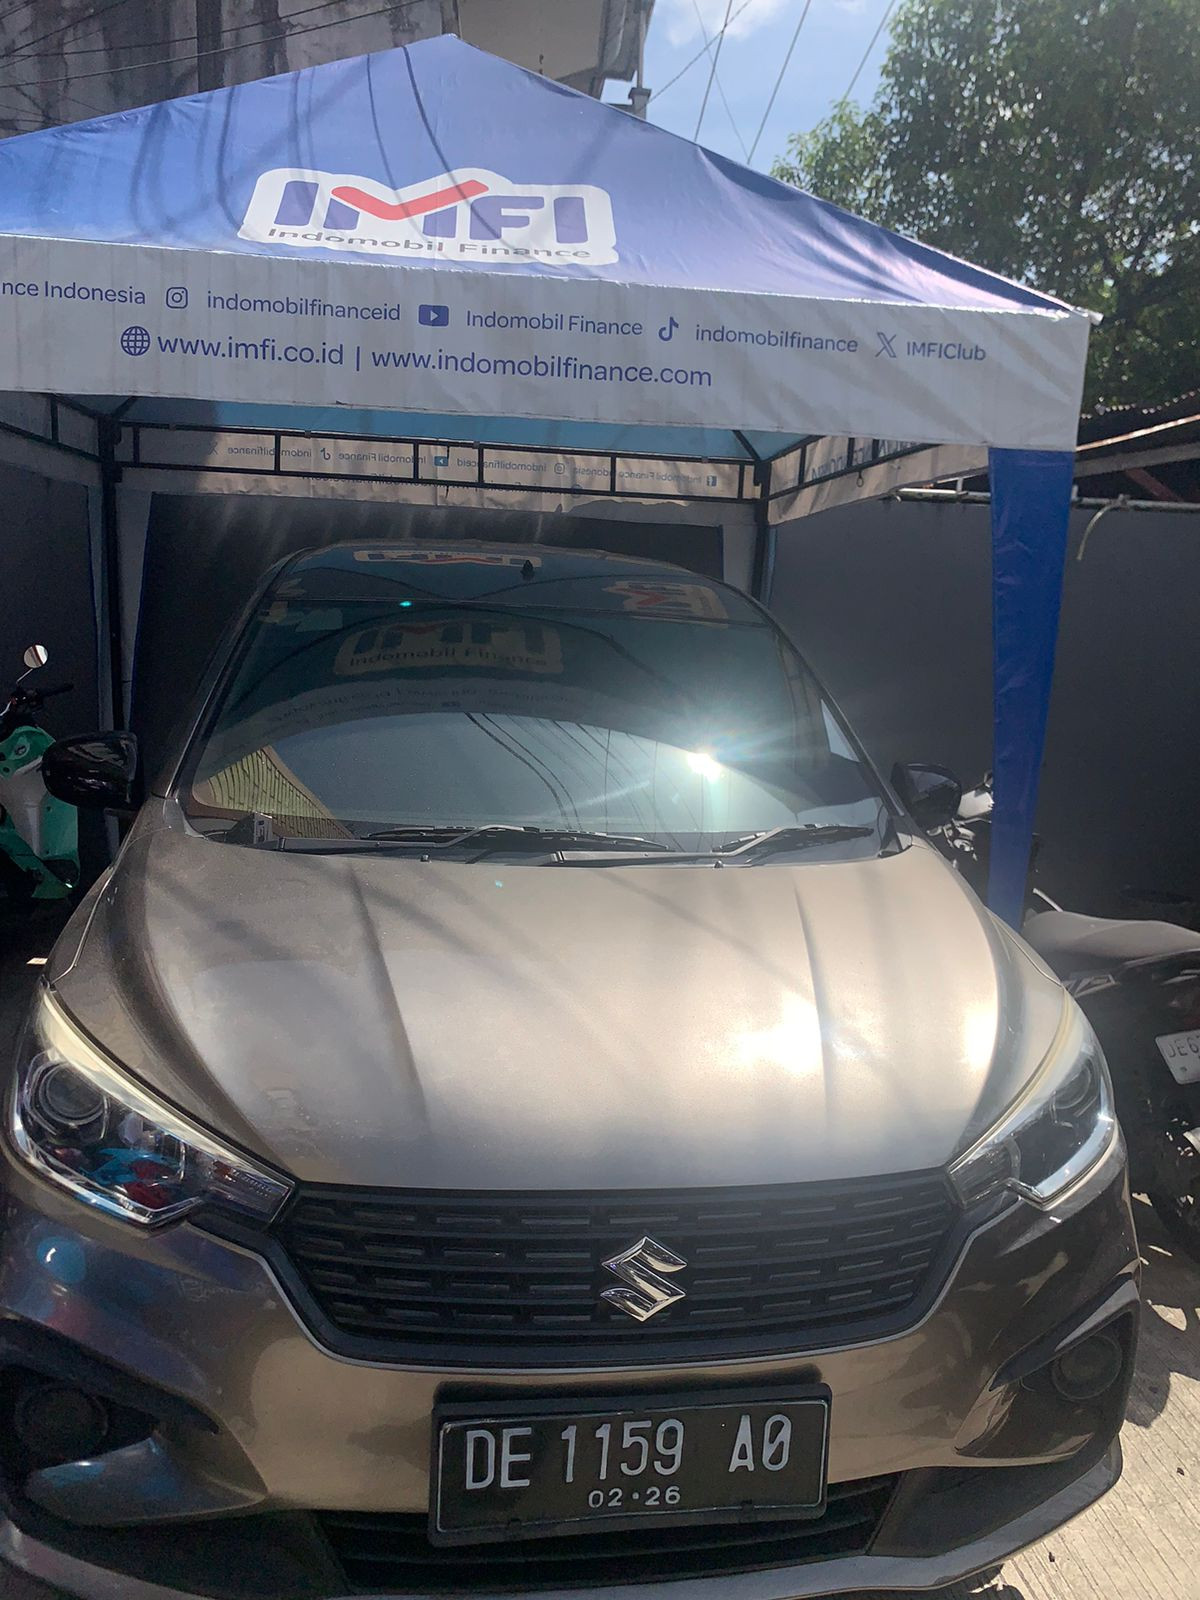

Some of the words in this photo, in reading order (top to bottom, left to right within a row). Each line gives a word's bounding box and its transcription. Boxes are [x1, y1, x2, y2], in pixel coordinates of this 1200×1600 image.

[267, 227, 445, 252] Indomobil
[459, 243, 592, 259] Finance
[273, 179, 589, 245] IMFI
[44, 280, 146, 305] Indonesia
[207, 290, 401, 321] indomobilfinanceid
[466, 310, 564, 332] Indomobil
[568, 315, 644, 336] Finance
[695, 324, 859, 353] indomobilfinance
[906, 341, 986, 361] IMFIClub
[157, 335, 345, 366] www.imfi.co.id
[371, 348, 713, 387] www.indomobilfinance.com
[465, 1426, 533, 1490] DE
[559, 1418, 685, 1483] 1159
